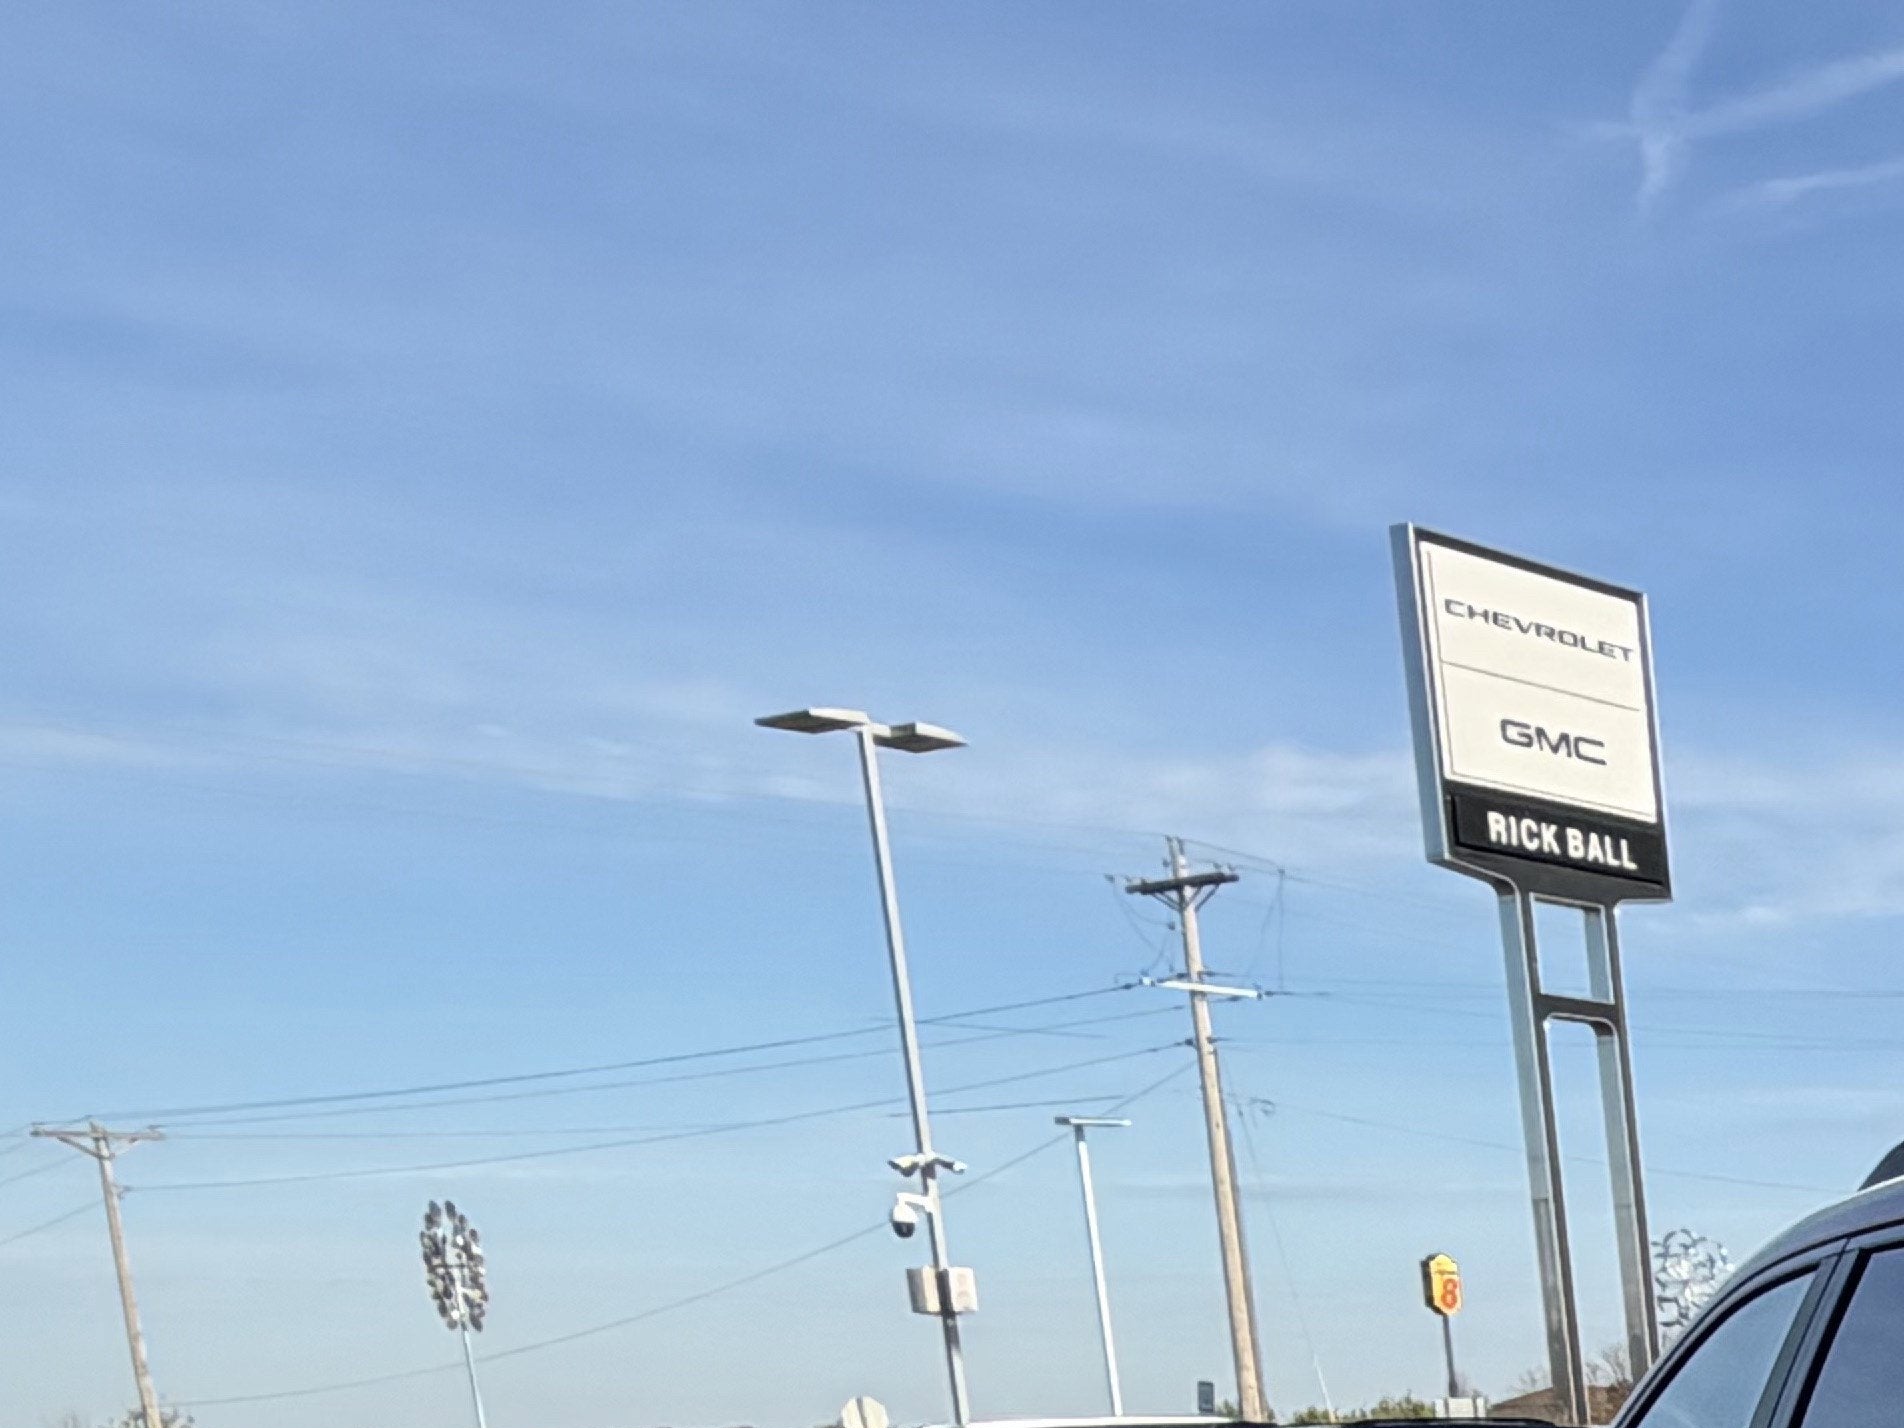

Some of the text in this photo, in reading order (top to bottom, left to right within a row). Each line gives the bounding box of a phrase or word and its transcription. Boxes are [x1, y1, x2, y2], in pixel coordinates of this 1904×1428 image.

[1444, 598, 1633, 663] CHEVROLET
[1501, 718, 1607, 766] GMC
[1487, 811, 1638, 870] RICK BALL
[1440, 1278, 1458, 1309] 8
